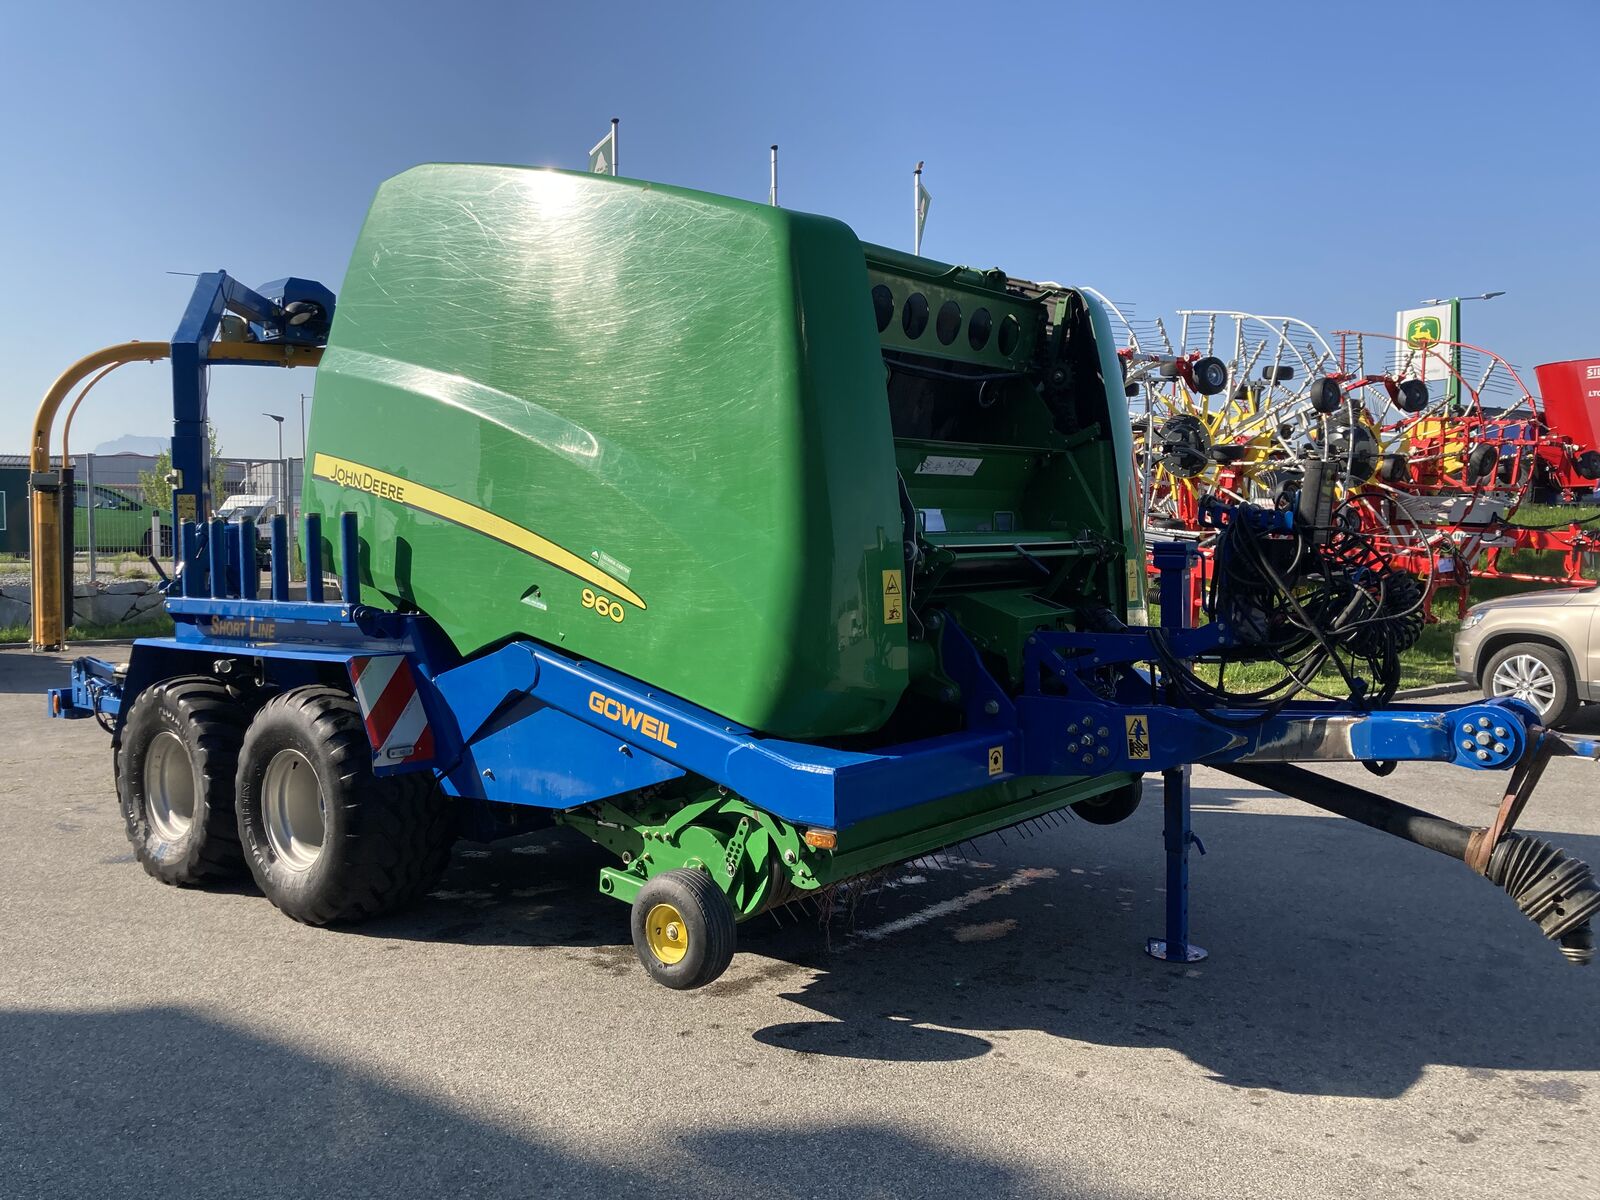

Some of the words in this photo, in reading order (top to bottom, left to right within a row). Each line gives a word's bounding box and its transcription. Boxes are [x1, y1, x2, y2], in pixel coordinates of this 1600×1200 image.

[330, 464, 362, 488] JOHN
[363, 473, 405, 501] DEERE
[581, 588, 625, 623] 960
[211, 615, 246, 636] SHORT
[249, 617, 275, 638] LINE
